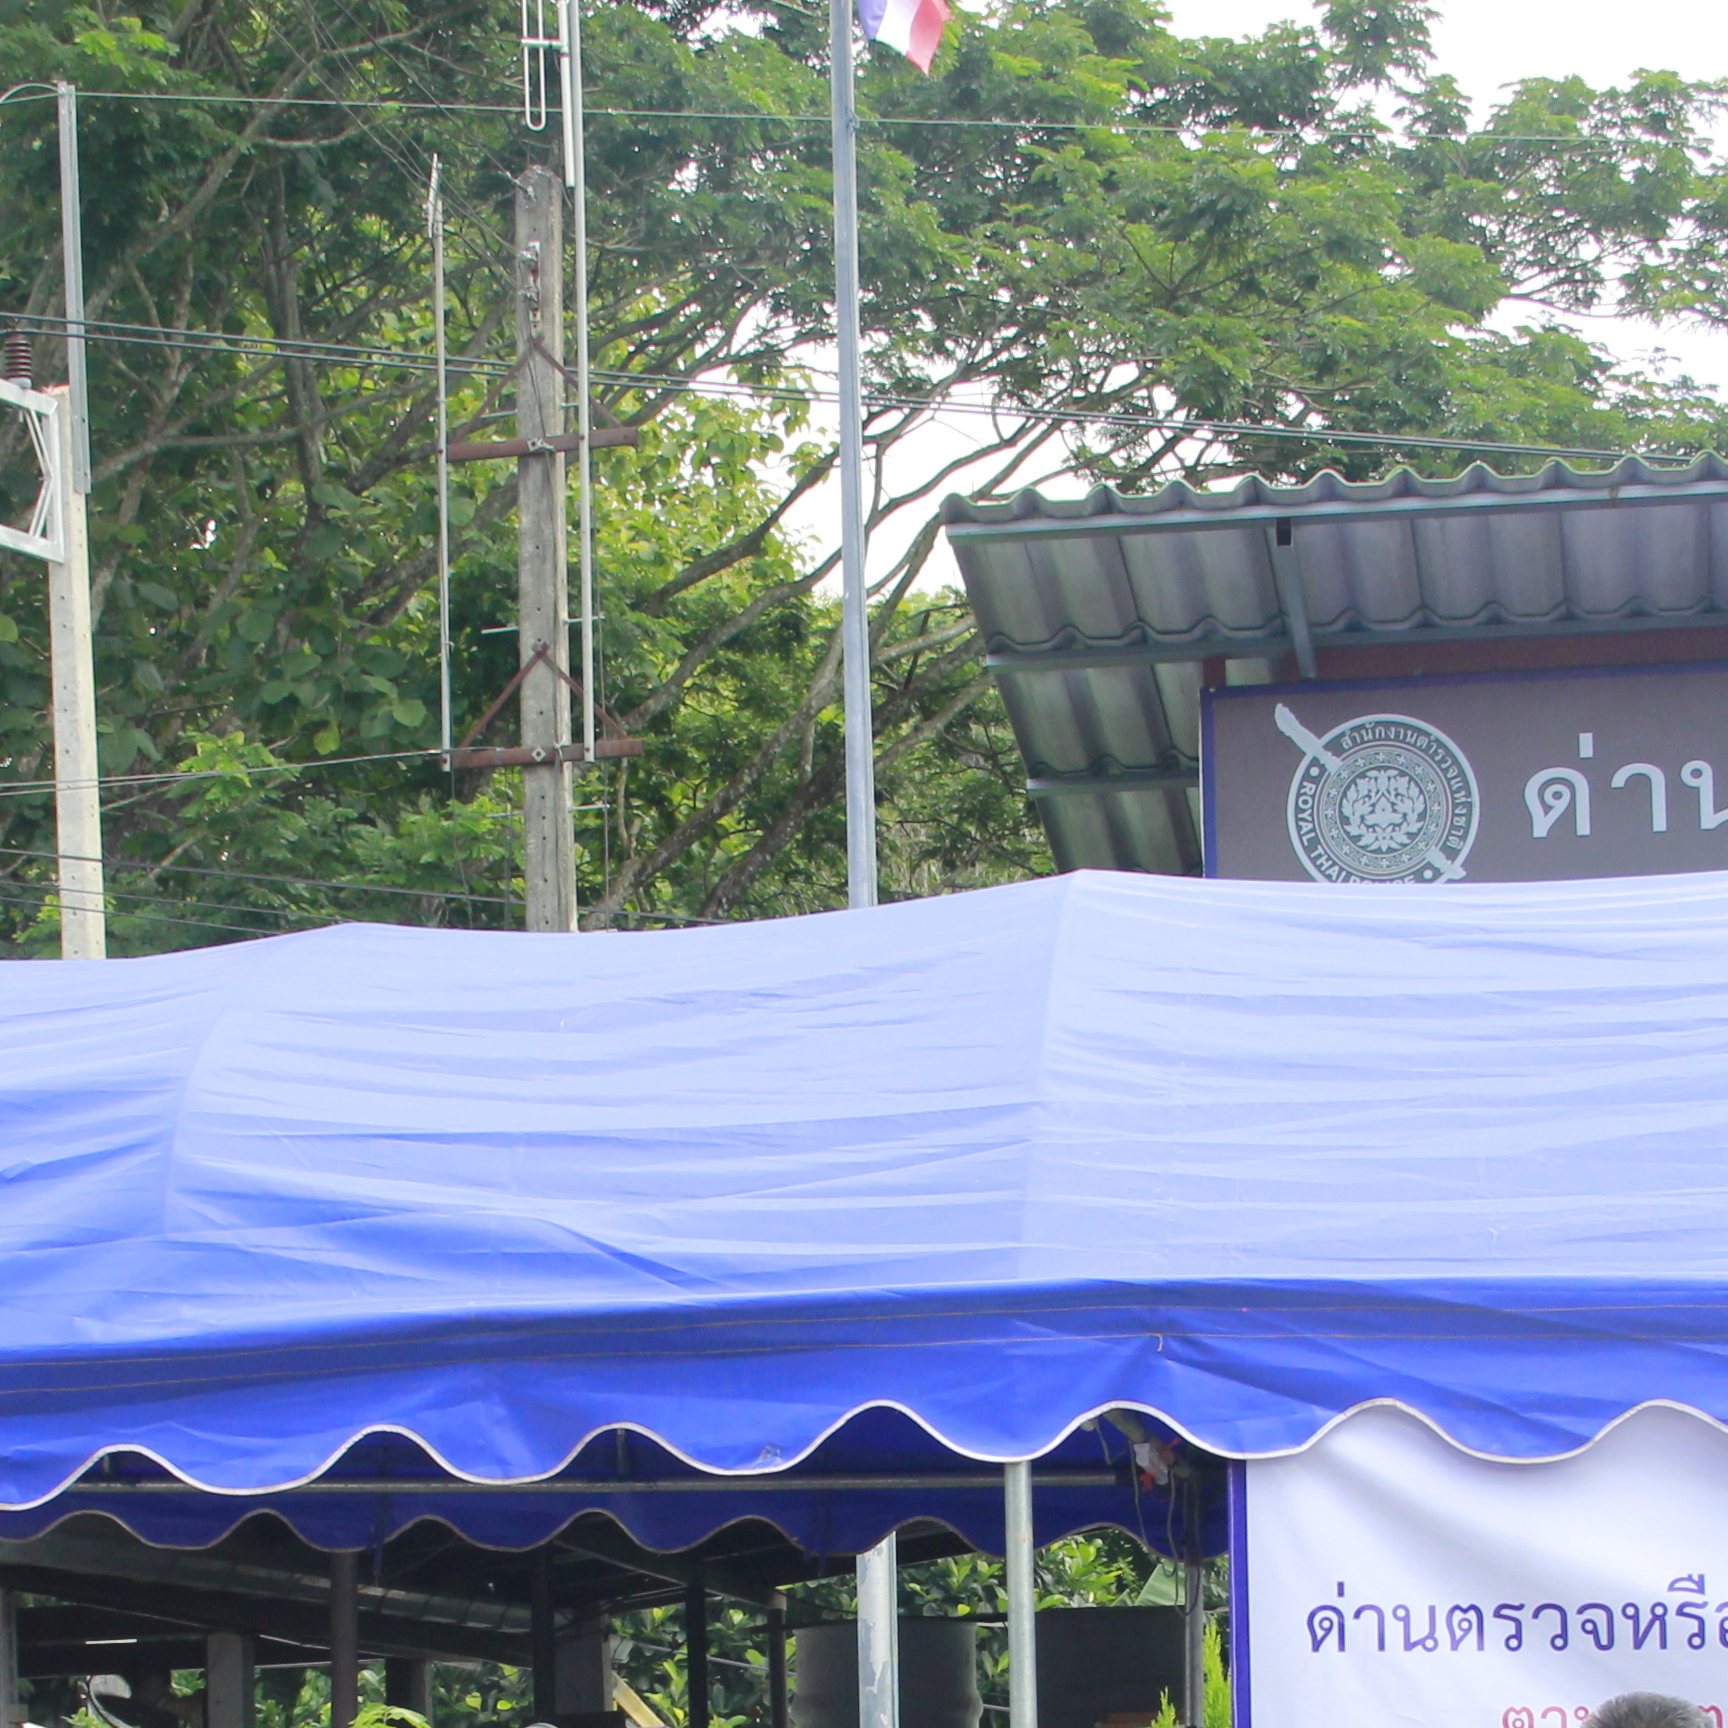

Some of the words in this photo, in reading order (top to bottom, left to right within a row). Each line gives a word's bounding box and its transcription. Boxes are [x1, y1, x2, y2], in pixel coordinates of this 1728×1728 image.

[1297, 780, 1315, 847] ROYAL
[1338, 721, 1473, 851] สำนักงานตำรวจแห่งชาติ
